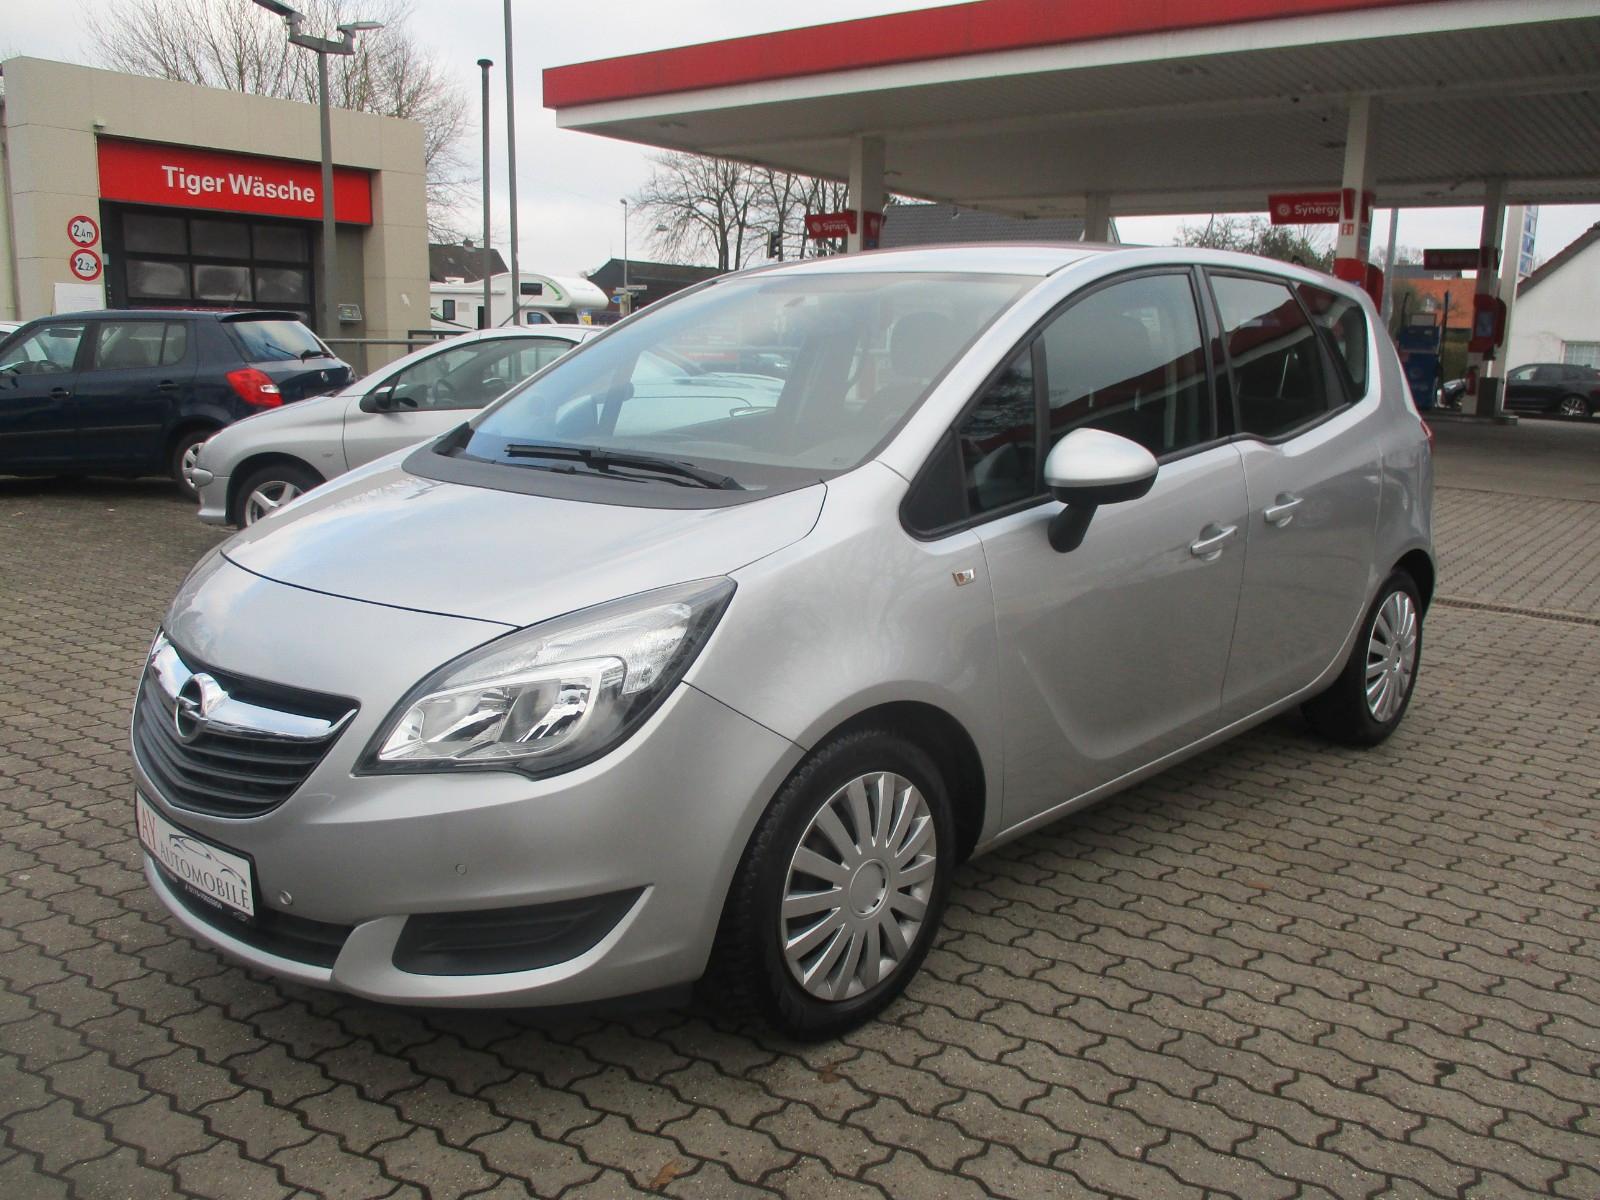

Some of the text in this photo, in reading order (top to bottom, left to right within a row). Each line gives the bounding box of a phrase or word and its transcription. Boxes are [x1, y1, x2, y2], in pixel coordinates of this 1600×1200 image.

[162, 164, 315, 203] Tiger Wäsche
[1294, 204, 1341, 217] Synergy
[160, 842, 250, 910] AUTOMOBILE
